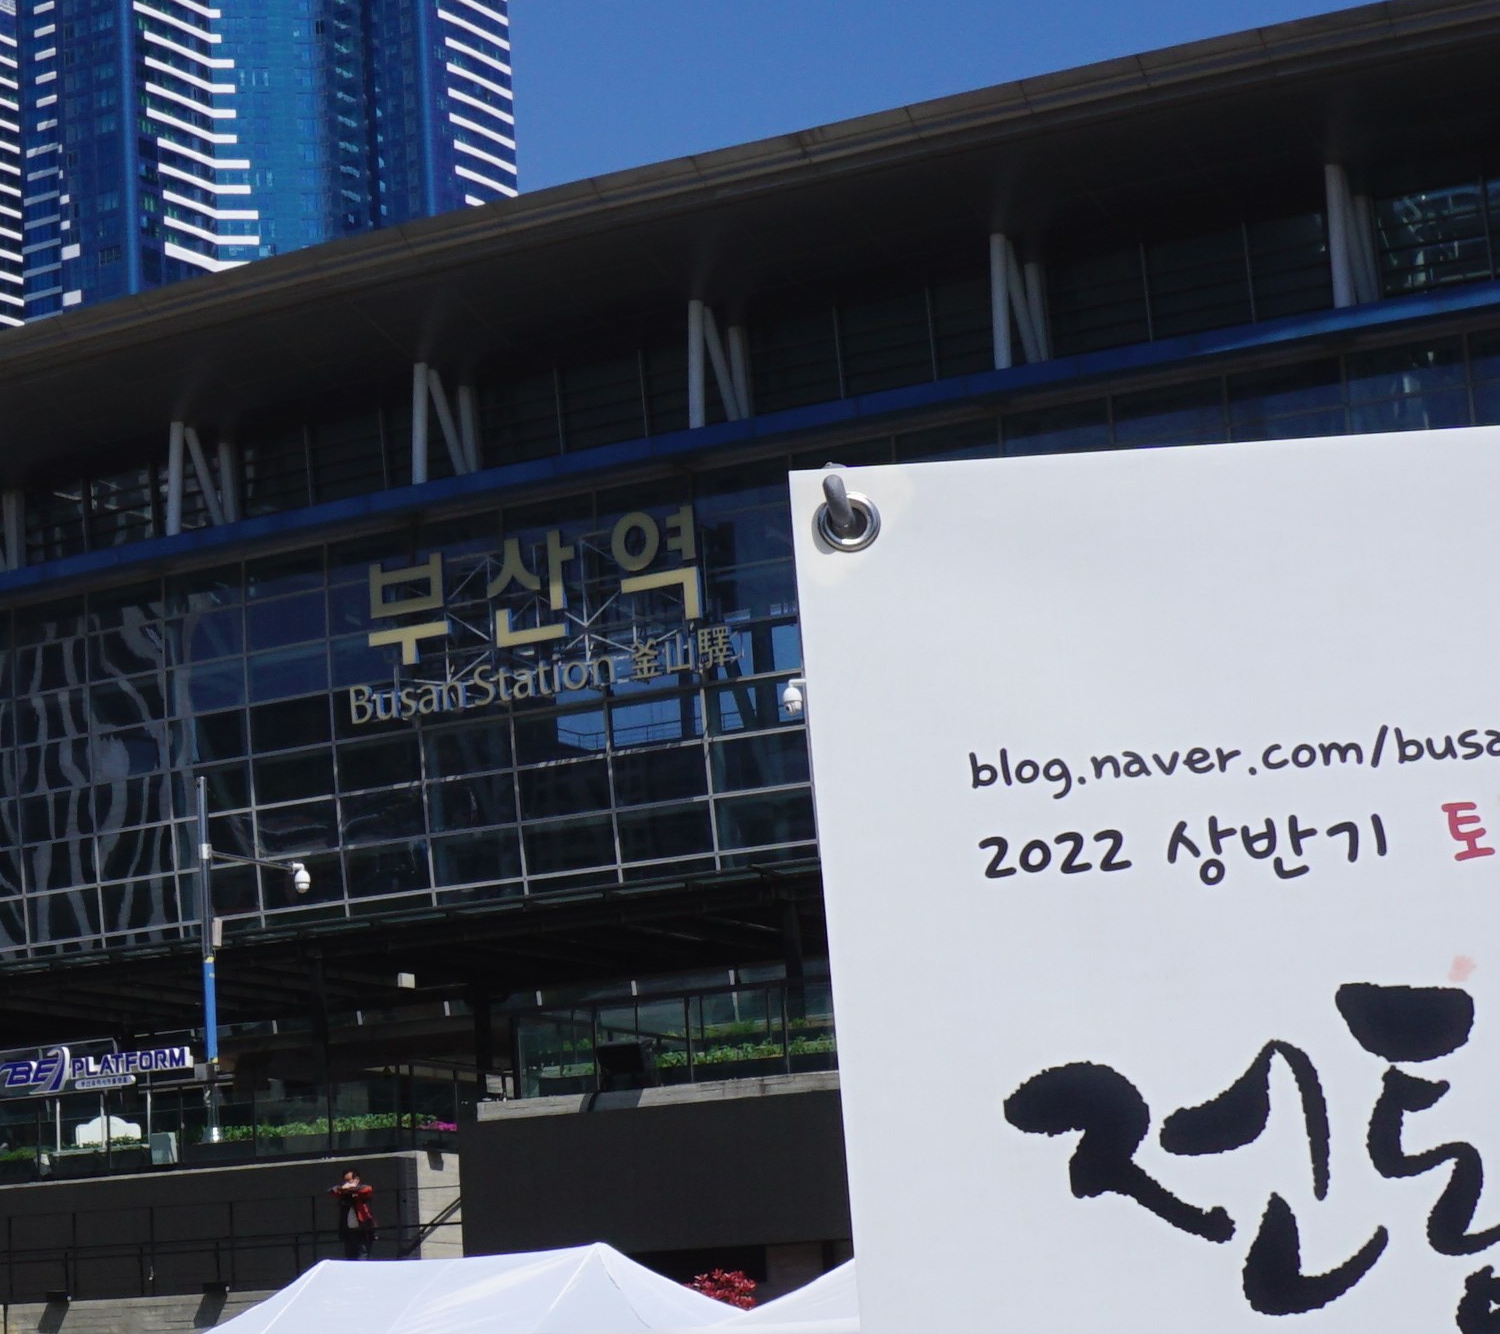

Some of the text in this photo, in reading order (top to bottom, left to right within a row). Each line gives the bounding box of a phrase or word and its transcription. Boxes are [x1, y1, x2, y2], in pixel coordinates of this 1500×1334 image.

[368, 505, 704, 665] 부산역
[349, 681, 467, 725] Busan
[471, 653, 616, 703] Station
[978, 829, 1132, 879] 2022
[1167, 813, 1387, 885] 상반기
[71, 1047, 190, 1078] PLATFORM
